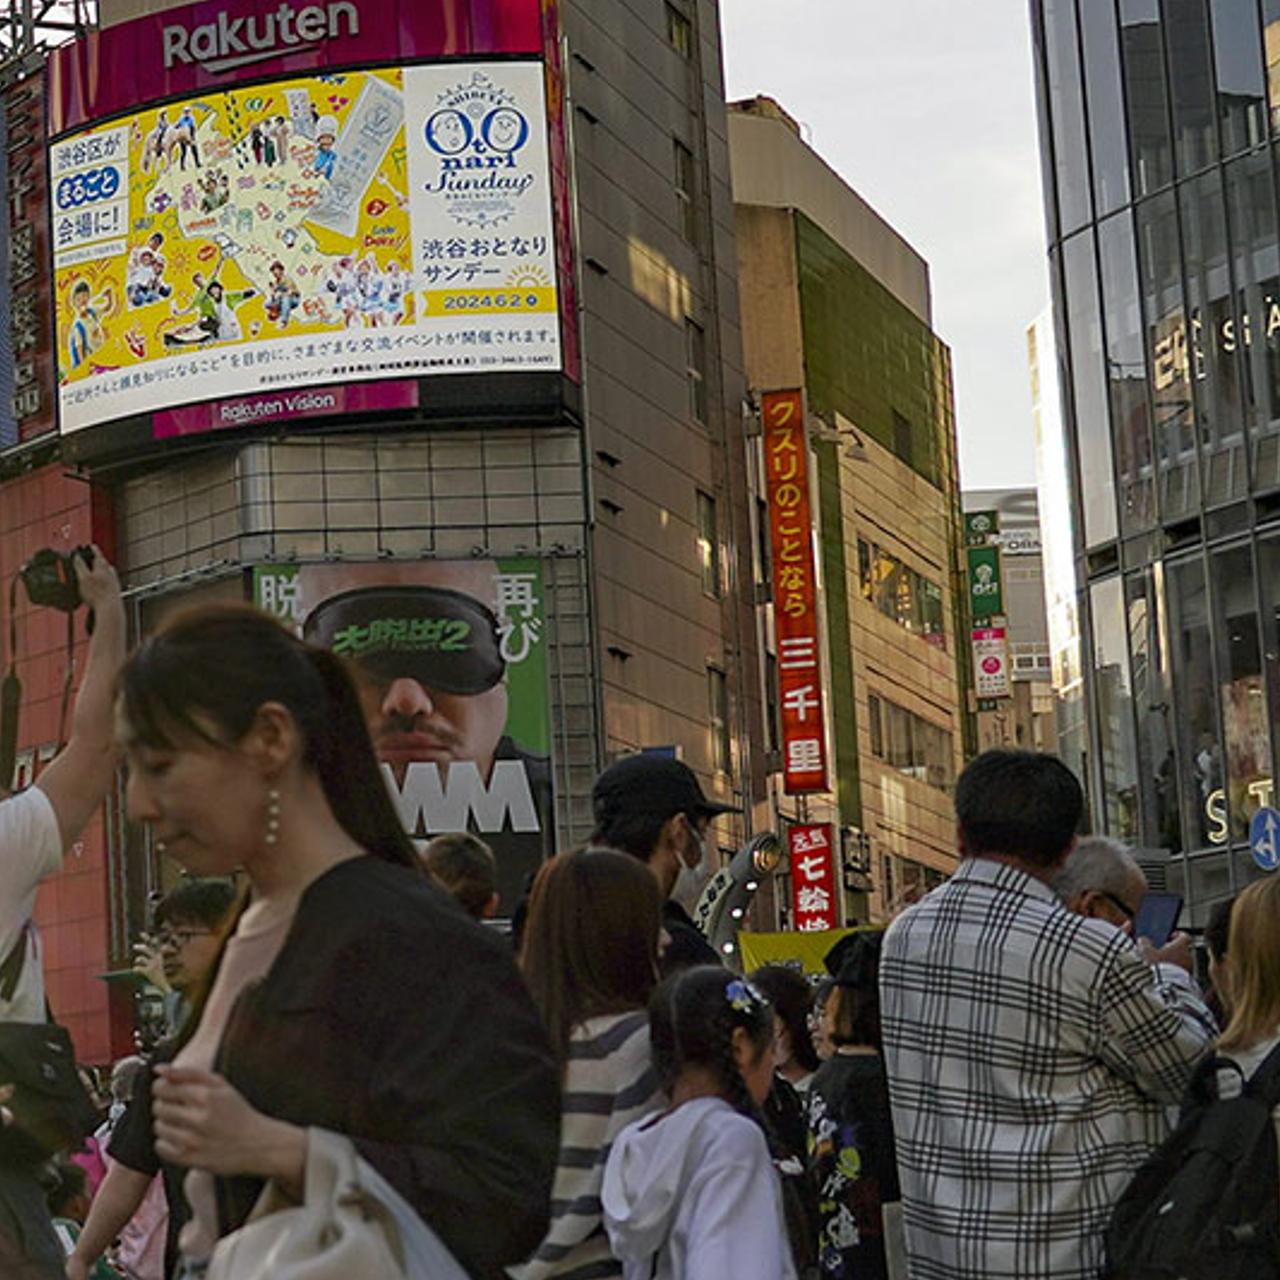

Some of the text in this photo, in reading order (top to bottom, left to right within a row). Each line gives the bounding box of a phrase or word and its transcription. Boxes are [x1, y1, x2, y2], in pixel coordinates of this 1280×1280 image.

[163, 0, 359, 70] Rakuten
[423, 236, 547, 259] 渋谷おとなり
[423, 261, 501, 283] サンデー
[221, 390, 335, 422] Rakuten Vision
[771, 401, 823, 775] クスリのことなら 三千里
[492, 573, 542, 663] 再び
